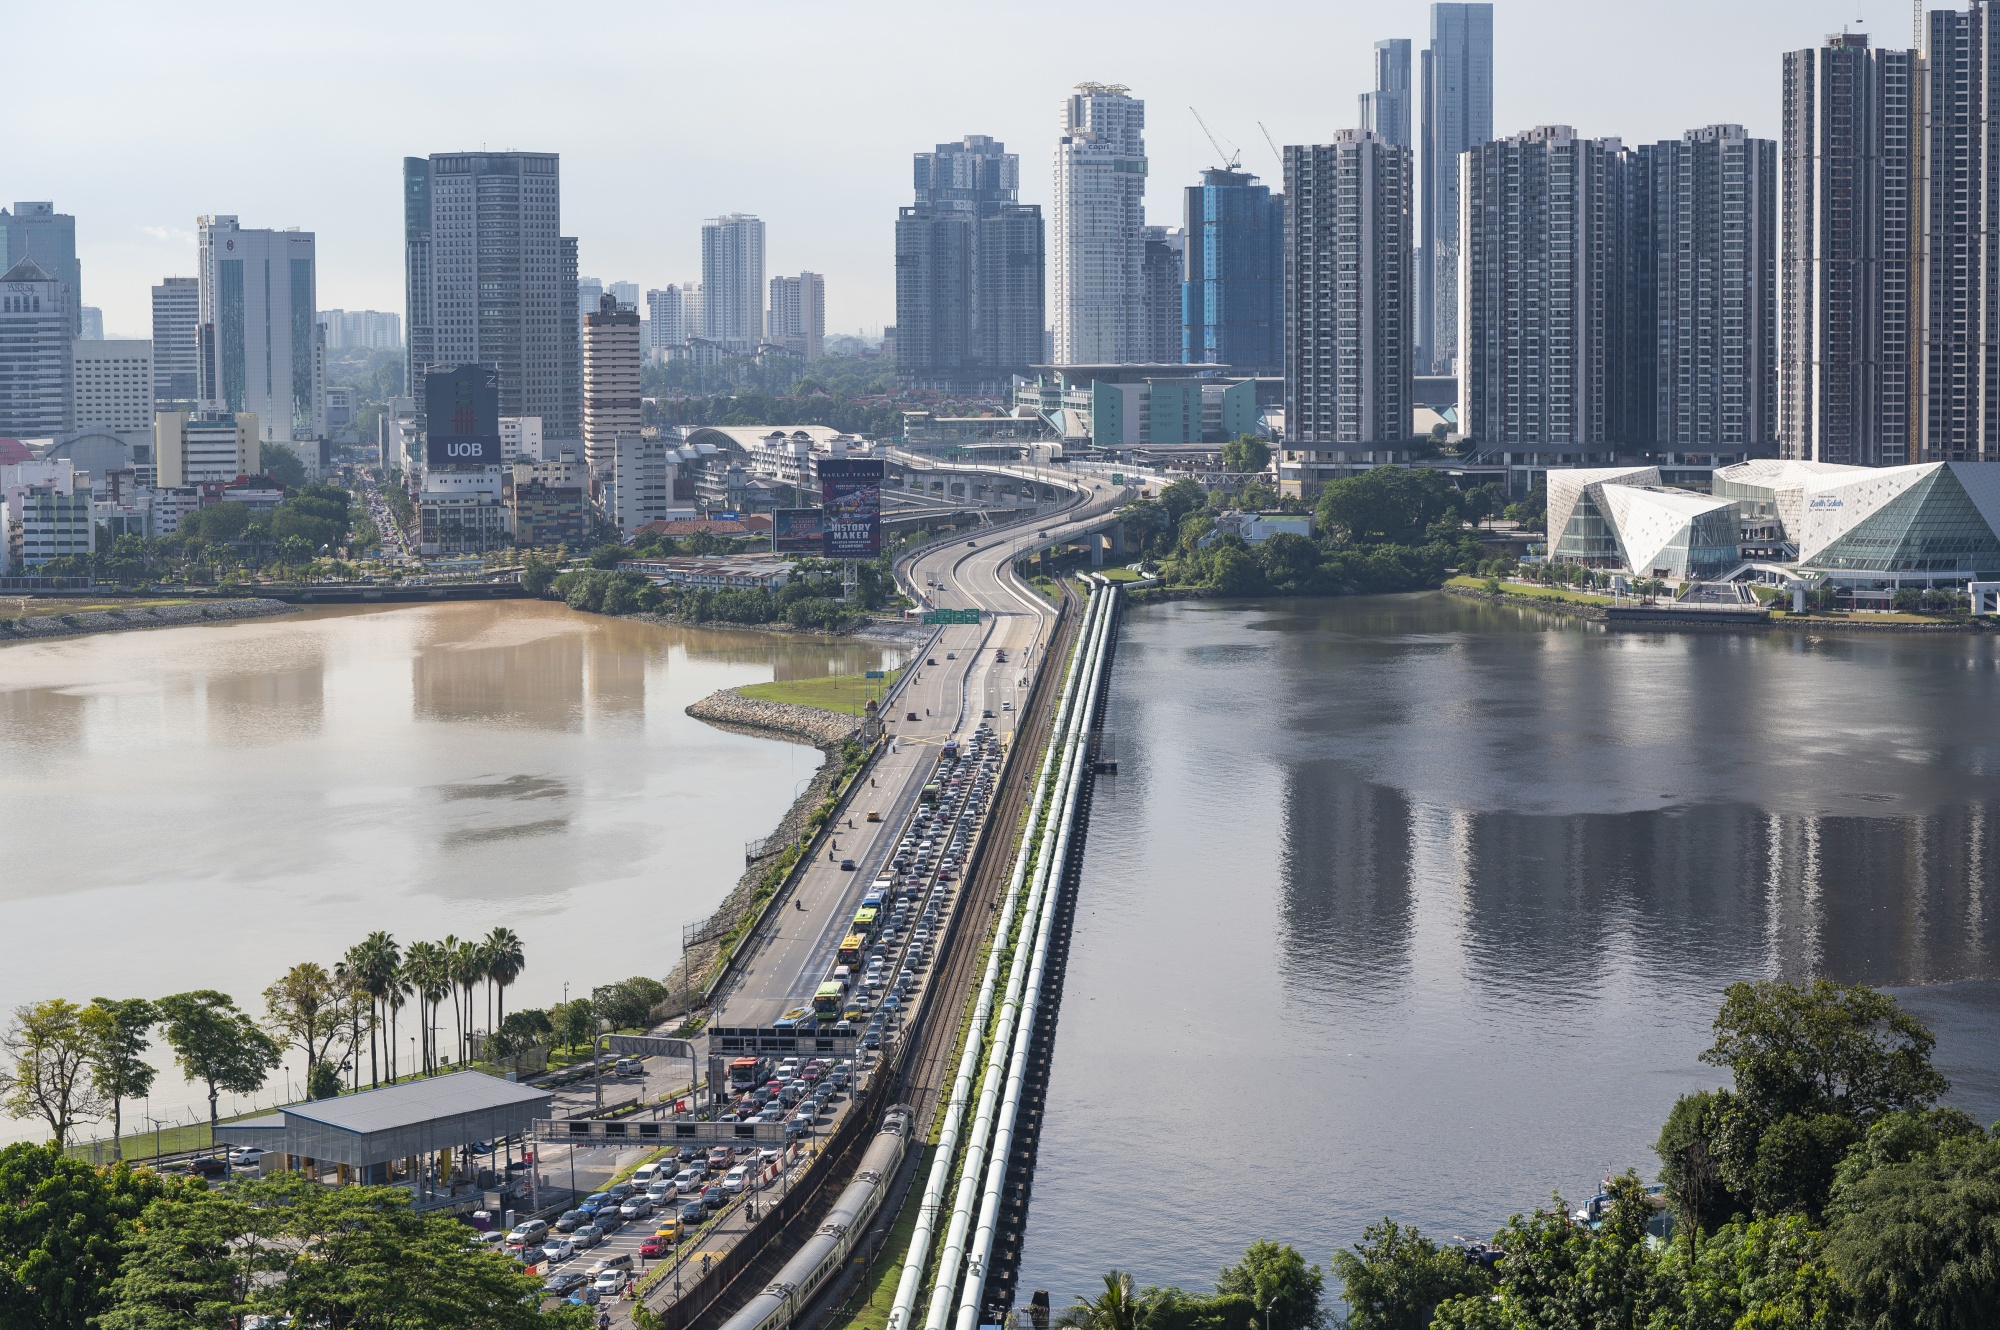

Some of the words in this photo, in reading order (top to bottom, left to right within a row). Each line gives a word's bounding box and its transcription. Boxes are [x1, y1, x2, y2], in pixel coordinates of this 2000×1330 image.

[447, 443, 483, 457] UOB
[831, 523, 871, 532] HISTORY
[833, 531, 869, 540] MAKER
